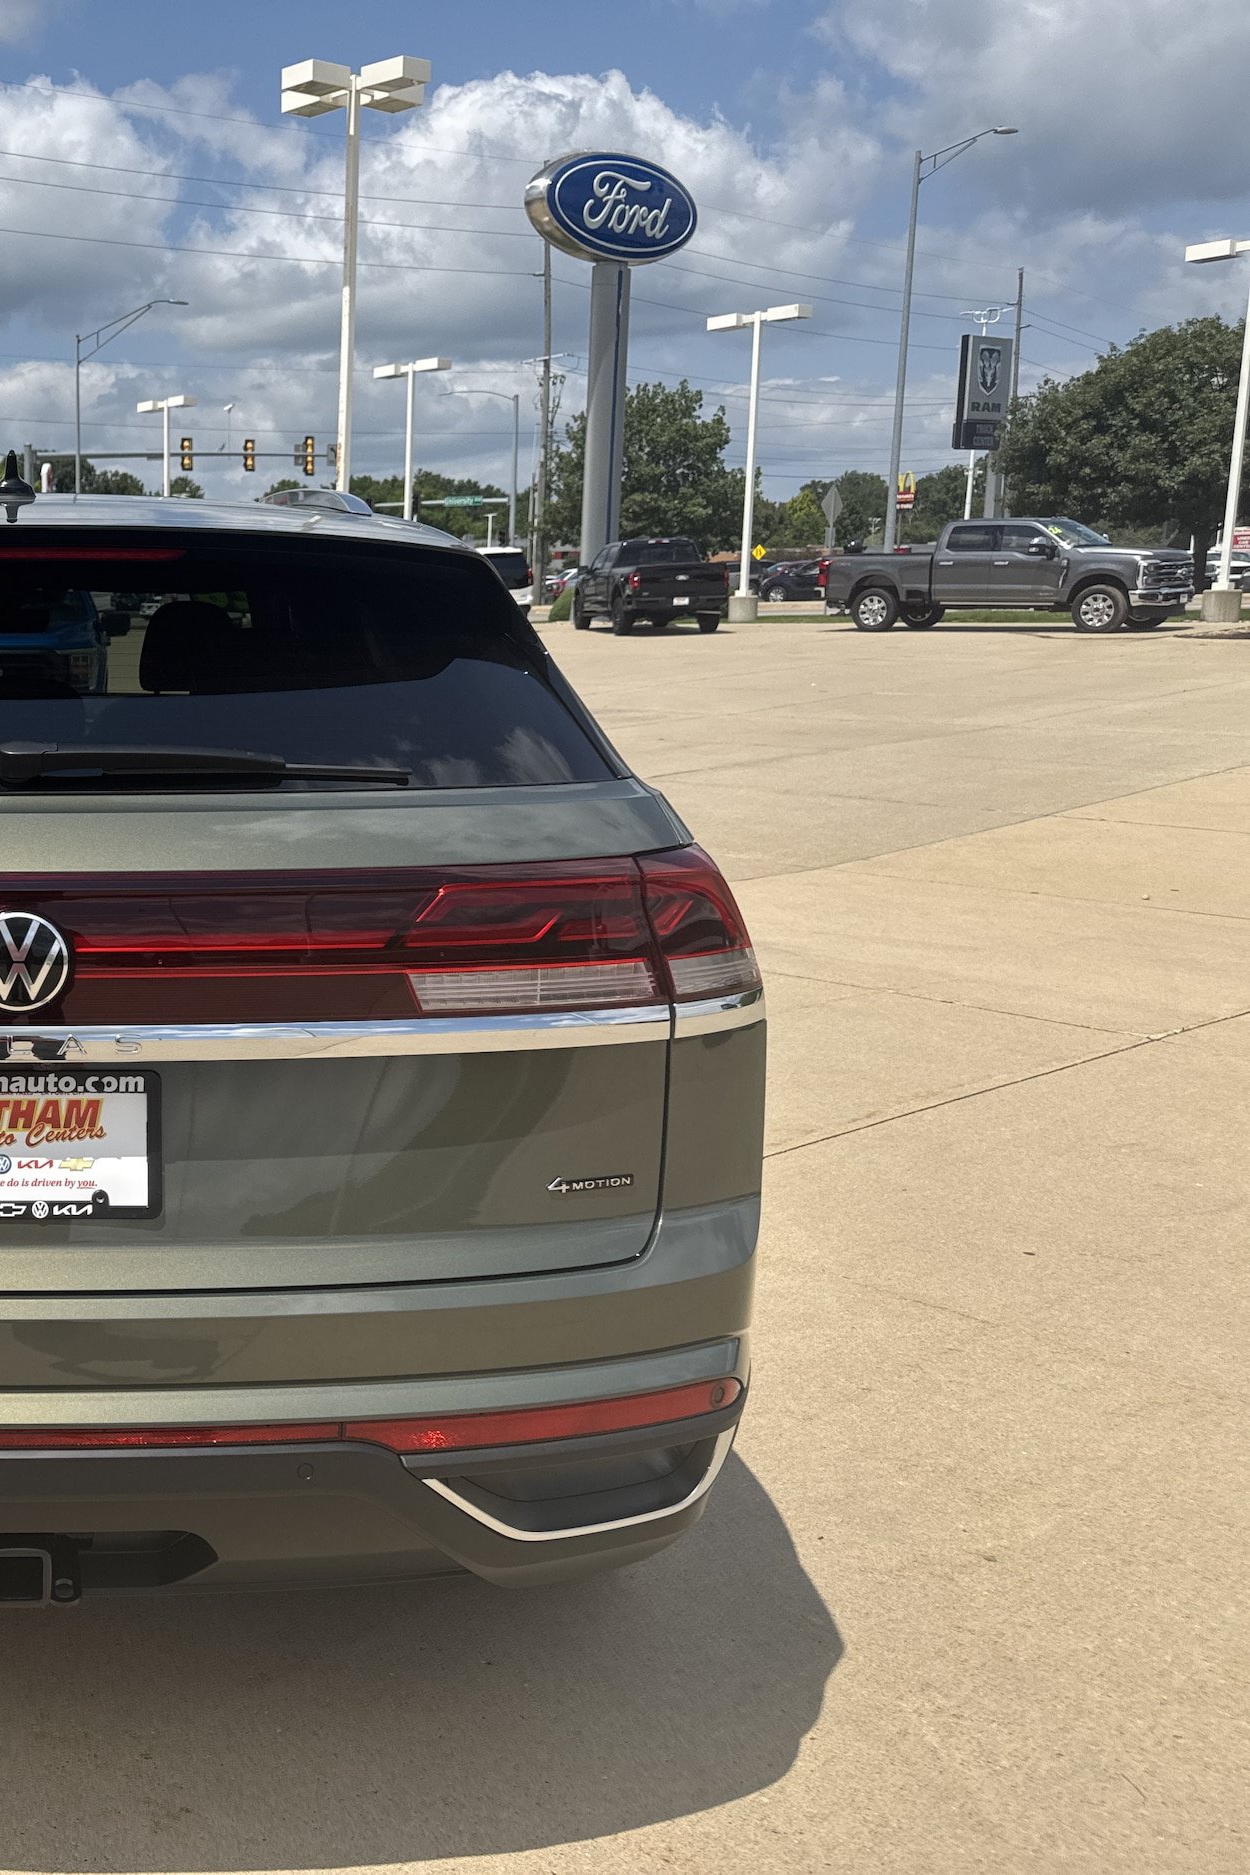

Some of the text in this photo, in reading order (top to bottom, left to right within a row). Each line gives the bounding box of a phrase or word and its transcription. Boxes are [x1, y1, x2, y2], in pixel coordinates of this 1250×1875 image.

[583, 171, 672, 239] Ford
[971, 402, 1001, 412] RAM
[25, 1122, 107, 1148] Centers
[7, 1179, 19, 1187] do
[21, 1178, 29, 1187] is
[31, 1178, 62, 1187] driven
[64, 1178, 75, 1189] by
